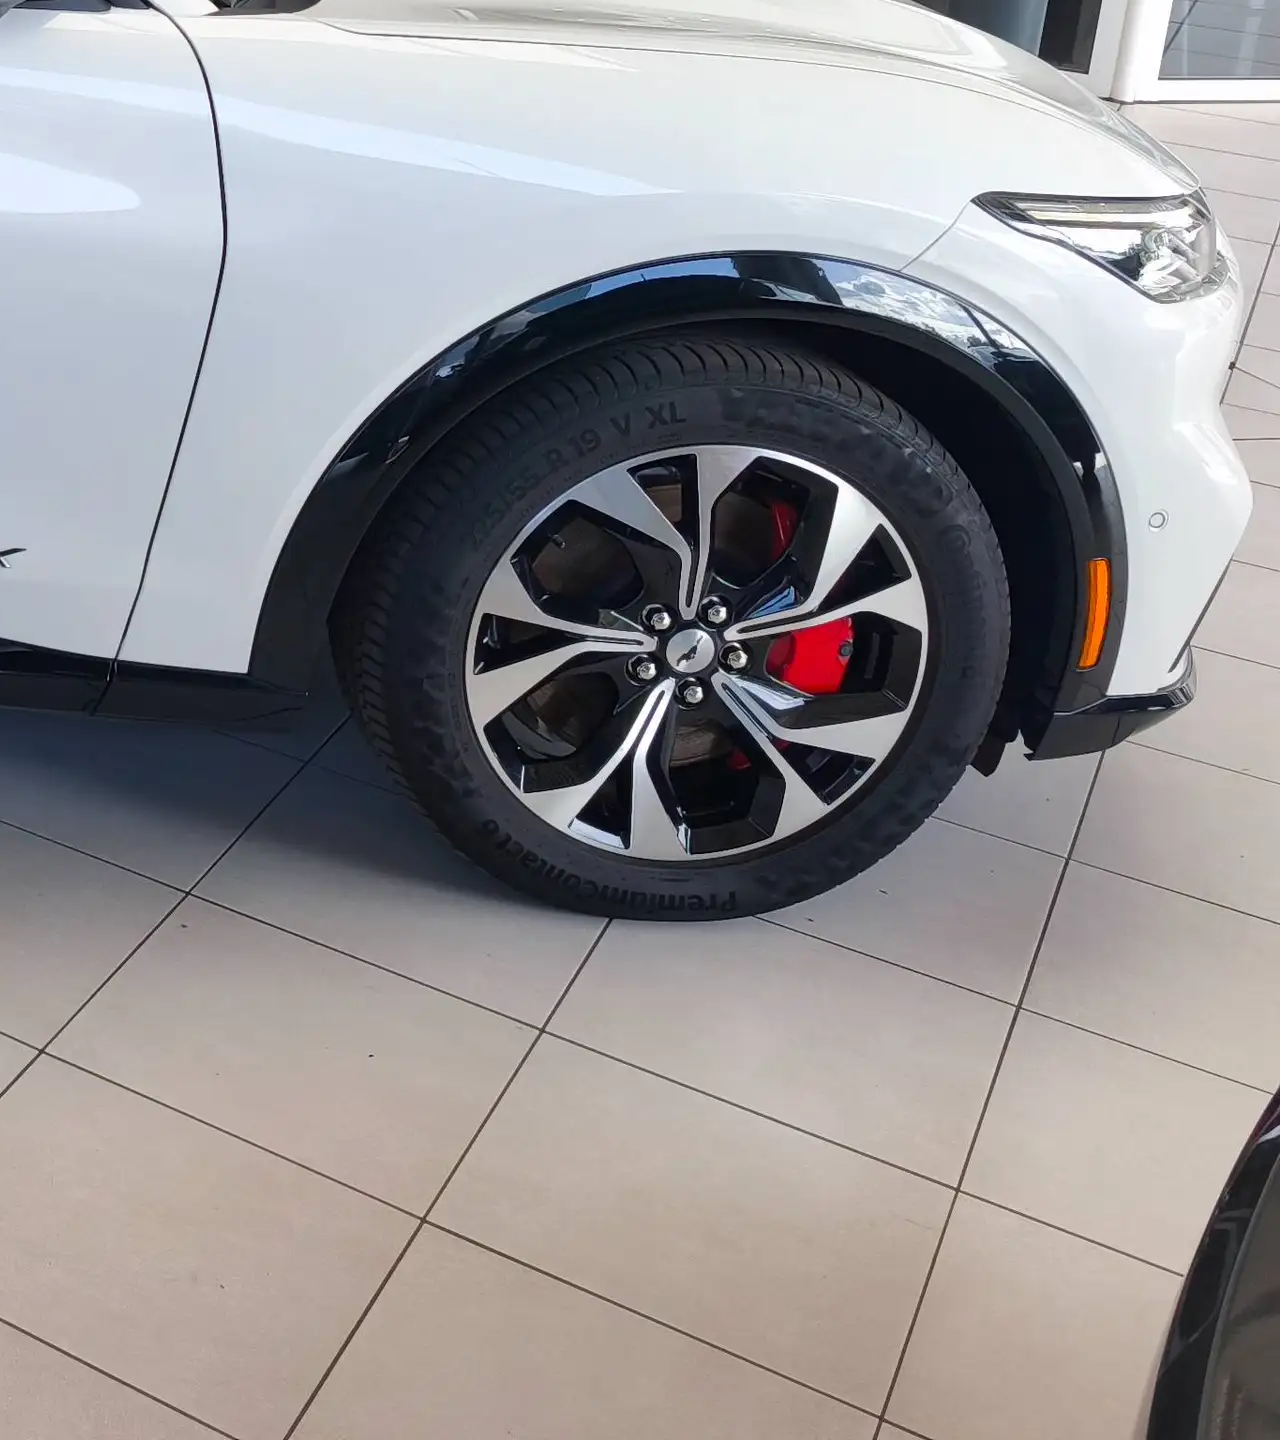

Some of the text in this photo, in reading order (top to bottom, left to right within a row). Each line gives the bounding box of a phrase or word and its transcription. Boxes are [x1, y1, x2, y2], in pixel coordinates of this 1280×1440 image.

[568, 427, 602, 456] 19
[609, 412, 632, 437] V
[645, 400, 687, 430] XL
